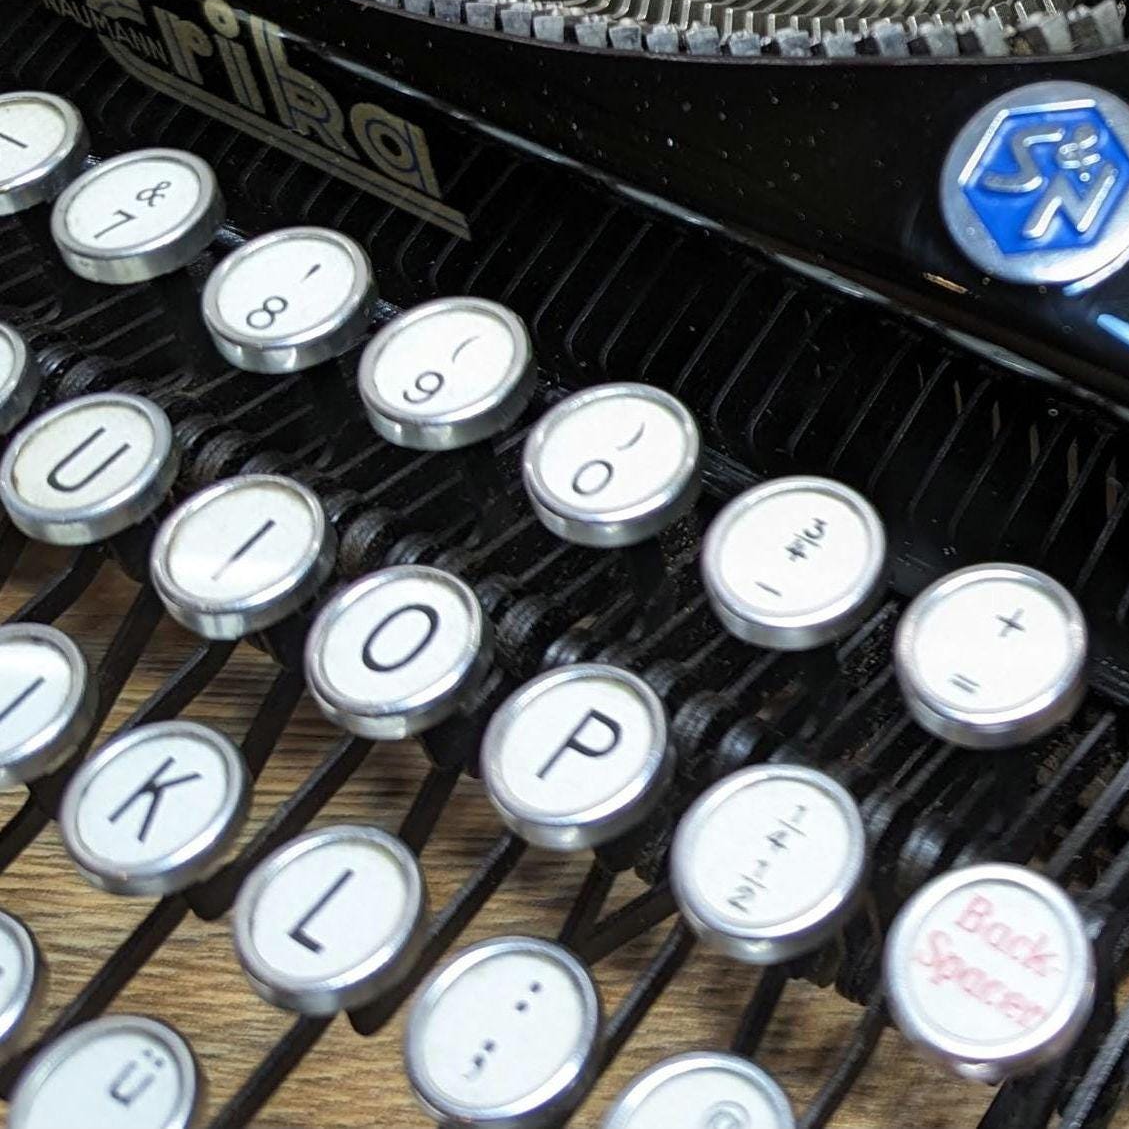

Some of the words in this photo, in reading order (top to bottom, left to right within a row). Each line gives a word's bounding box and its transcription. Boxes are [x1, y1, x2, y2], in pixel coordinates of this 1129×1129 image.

[93, 209, 137, 240] 7
[246, 295, 289, 331] 8
[402, 370, 445, 404] 9
[47, 426, 132, 493] U
[361, 603, 440, 673] O
[536, 708, 623, 780] P
[107, 755, 203, 844] K
[288, 868, 357, 956] L
[953, 893, 1060, 977] Back
